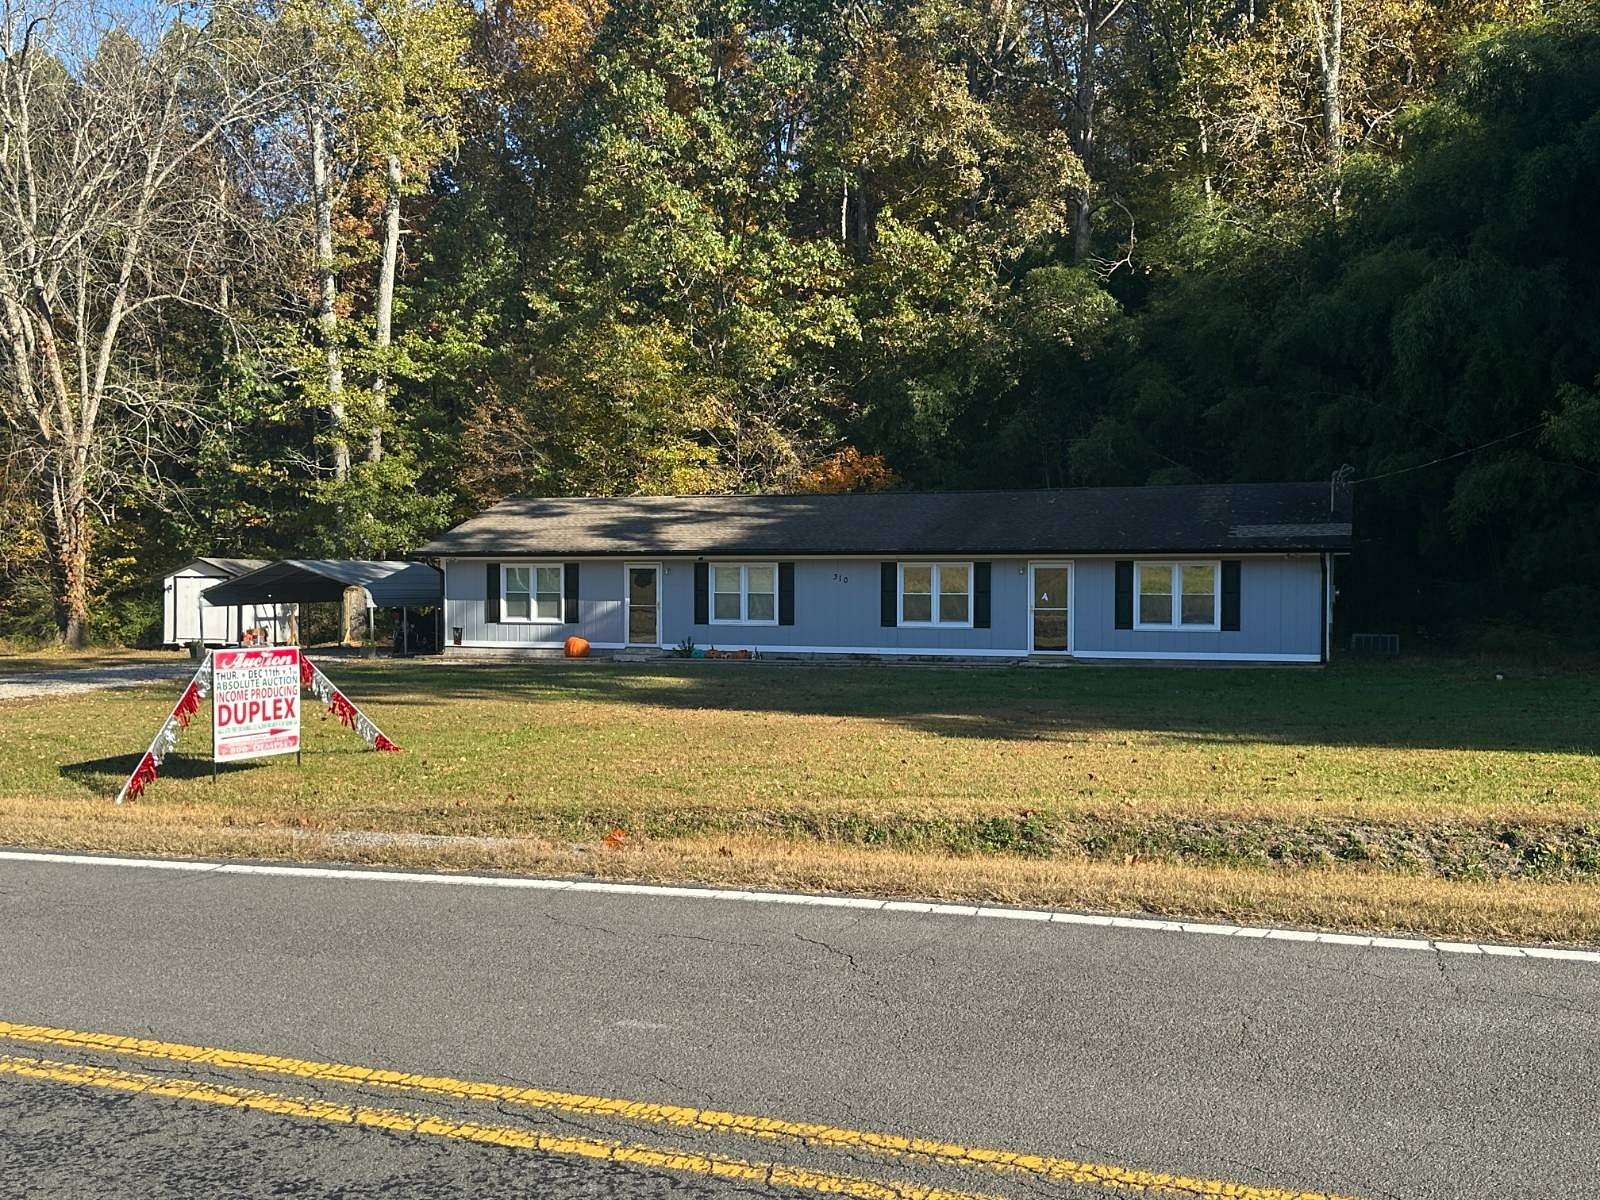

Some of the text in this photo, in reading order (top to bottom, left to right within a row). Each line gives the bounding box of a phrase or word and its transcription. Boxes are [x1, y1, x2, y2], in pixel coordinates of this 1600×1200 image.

[832, 573, 848, 584] 310
[221, 651, 293, 669] Auction
[216, 671, 239, 681] THUR.
[248, 669, 263, 679] DEC
[264, 667, 280, 677] 11th
[216, 675, 298, 691] ABSOLUTE AUCTION
[216, 685, 298, 703] INCOME PRODUCING
[217, 697, 297, 727] DUPLEX
